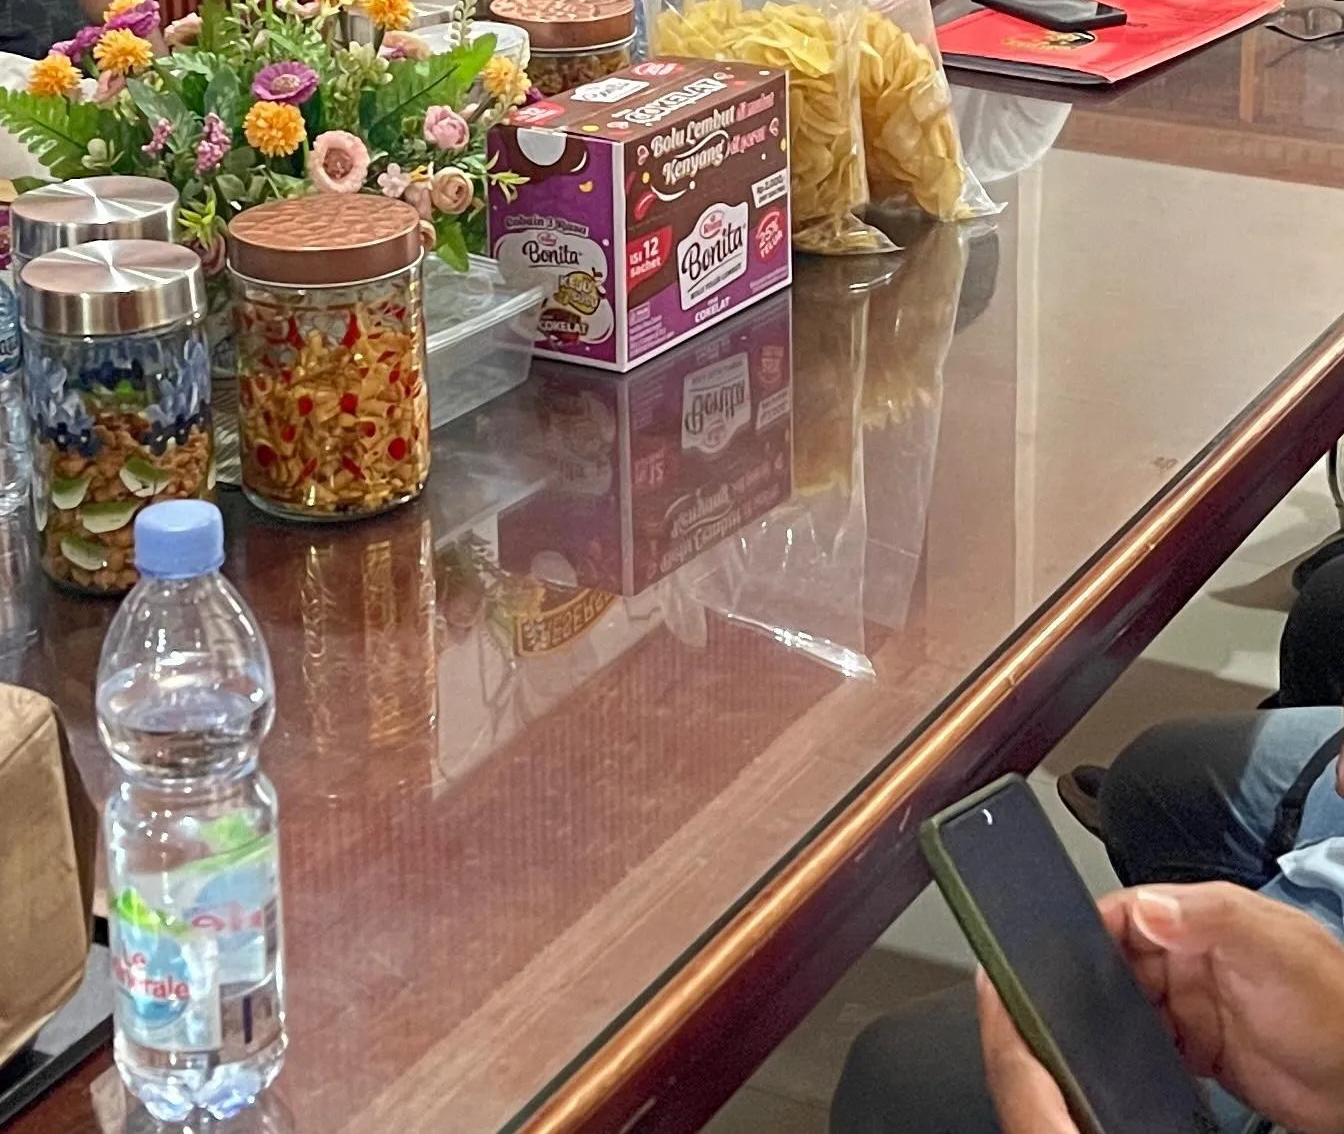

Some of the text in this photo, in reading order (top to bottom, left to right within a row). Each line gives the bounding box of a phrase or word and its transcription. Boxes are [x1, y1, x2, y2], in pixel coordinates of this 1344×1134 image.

[651, 127, 684, 157] Bolu
[685, 105, 735, 145] Lembut
[662, 139, 724, 185] Kenyang
[522, 240, 580, 265] Bonita
[643, 237, 659, 258] 12
[681, 222, 743, 281] Bonita
[630, 256, 662, 278] sachet
